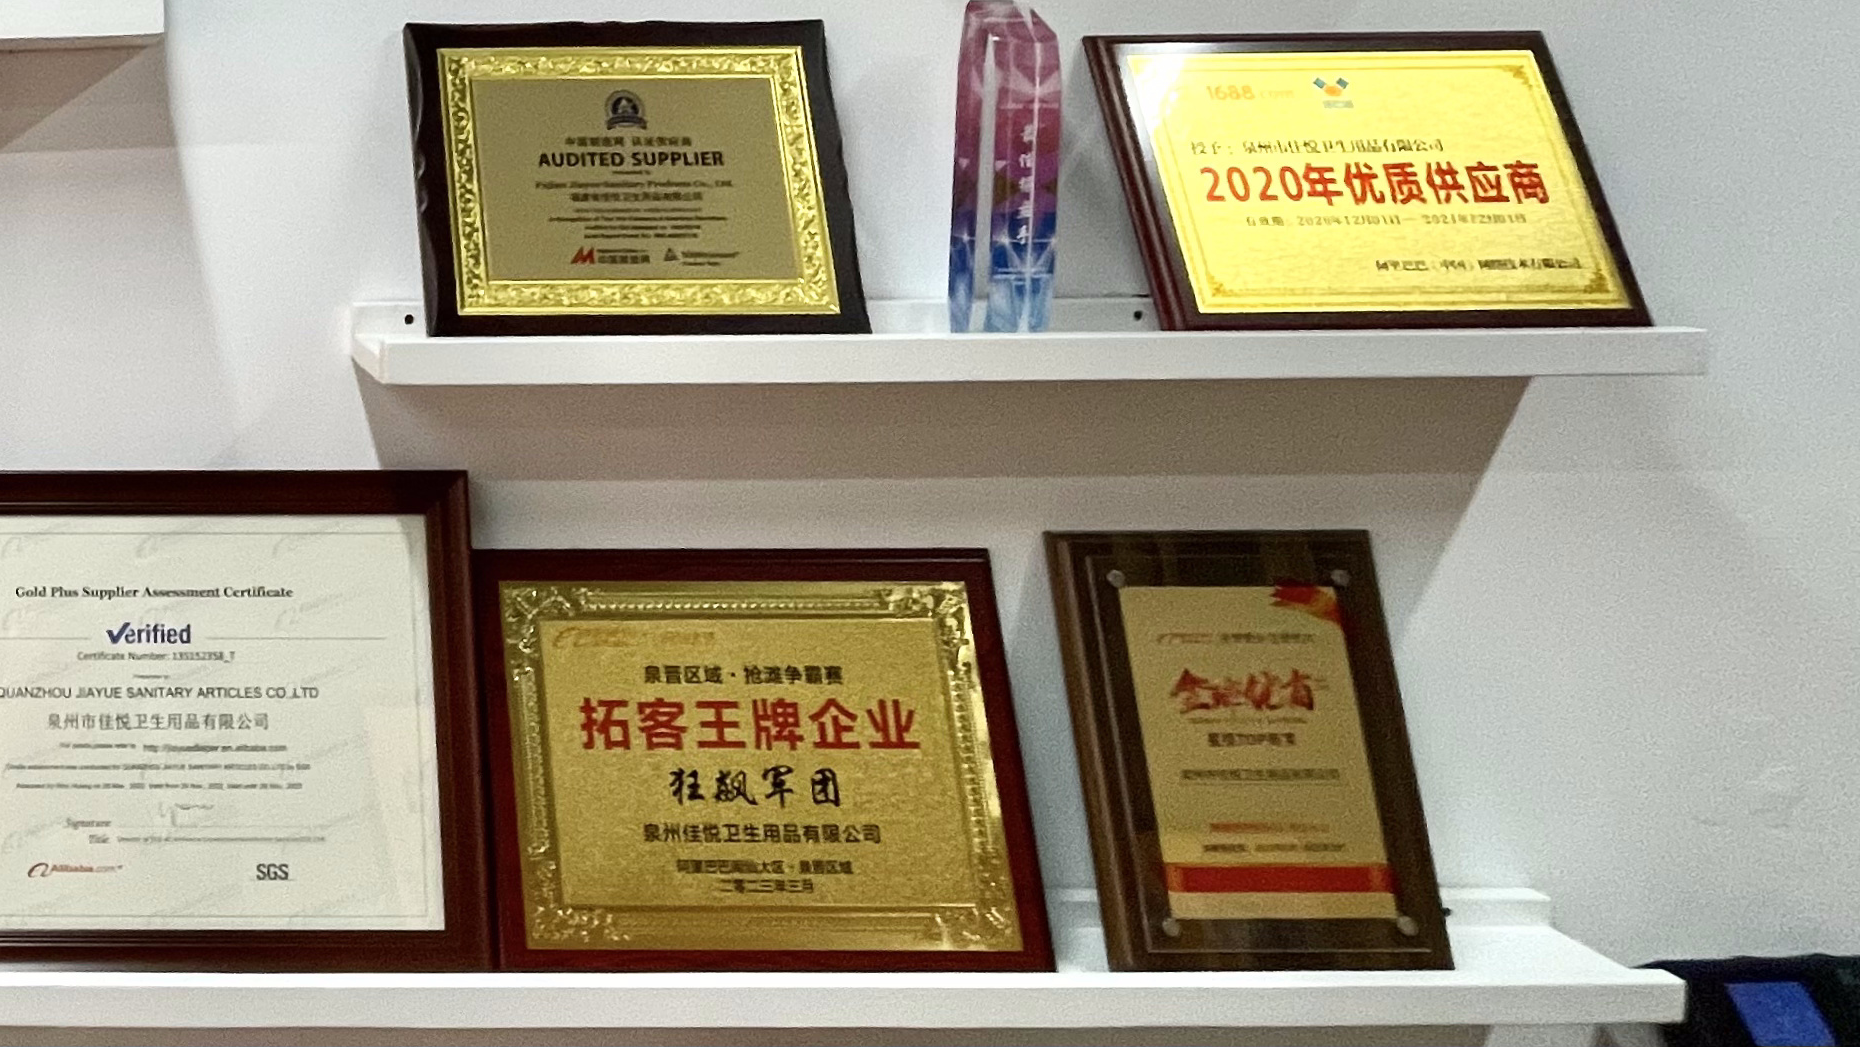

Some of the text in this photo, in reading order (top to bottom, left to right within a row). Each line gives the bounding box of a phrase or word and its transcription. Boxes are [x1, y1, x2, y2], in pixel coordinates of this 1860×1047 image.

[539, 151, 724, 167] AUDITED SUPPLIER
[1200, 160, 1550, 206] 2020年优质供应商
[16, 586, 293, 600] Gold Plus Supplier Assessment Certificate
[106, 622, 191, 644] Verified
[76, 687, 122, 699] JIAYUE
[126, 687, 191, 699] SANITARY
[197, 687, 262, 699] ARTICLES
[48, 713, 269, 730] 泉州市佳悦卫生用品有限公司
[580, 697, 922, 751] 拓客王牌企业
[670, 765, 840, 808] 狂飙军团
[643, 823, 881, 843] 泉州佳悦卫生用品有限公司
[256, 864, 289, 880] SGS
